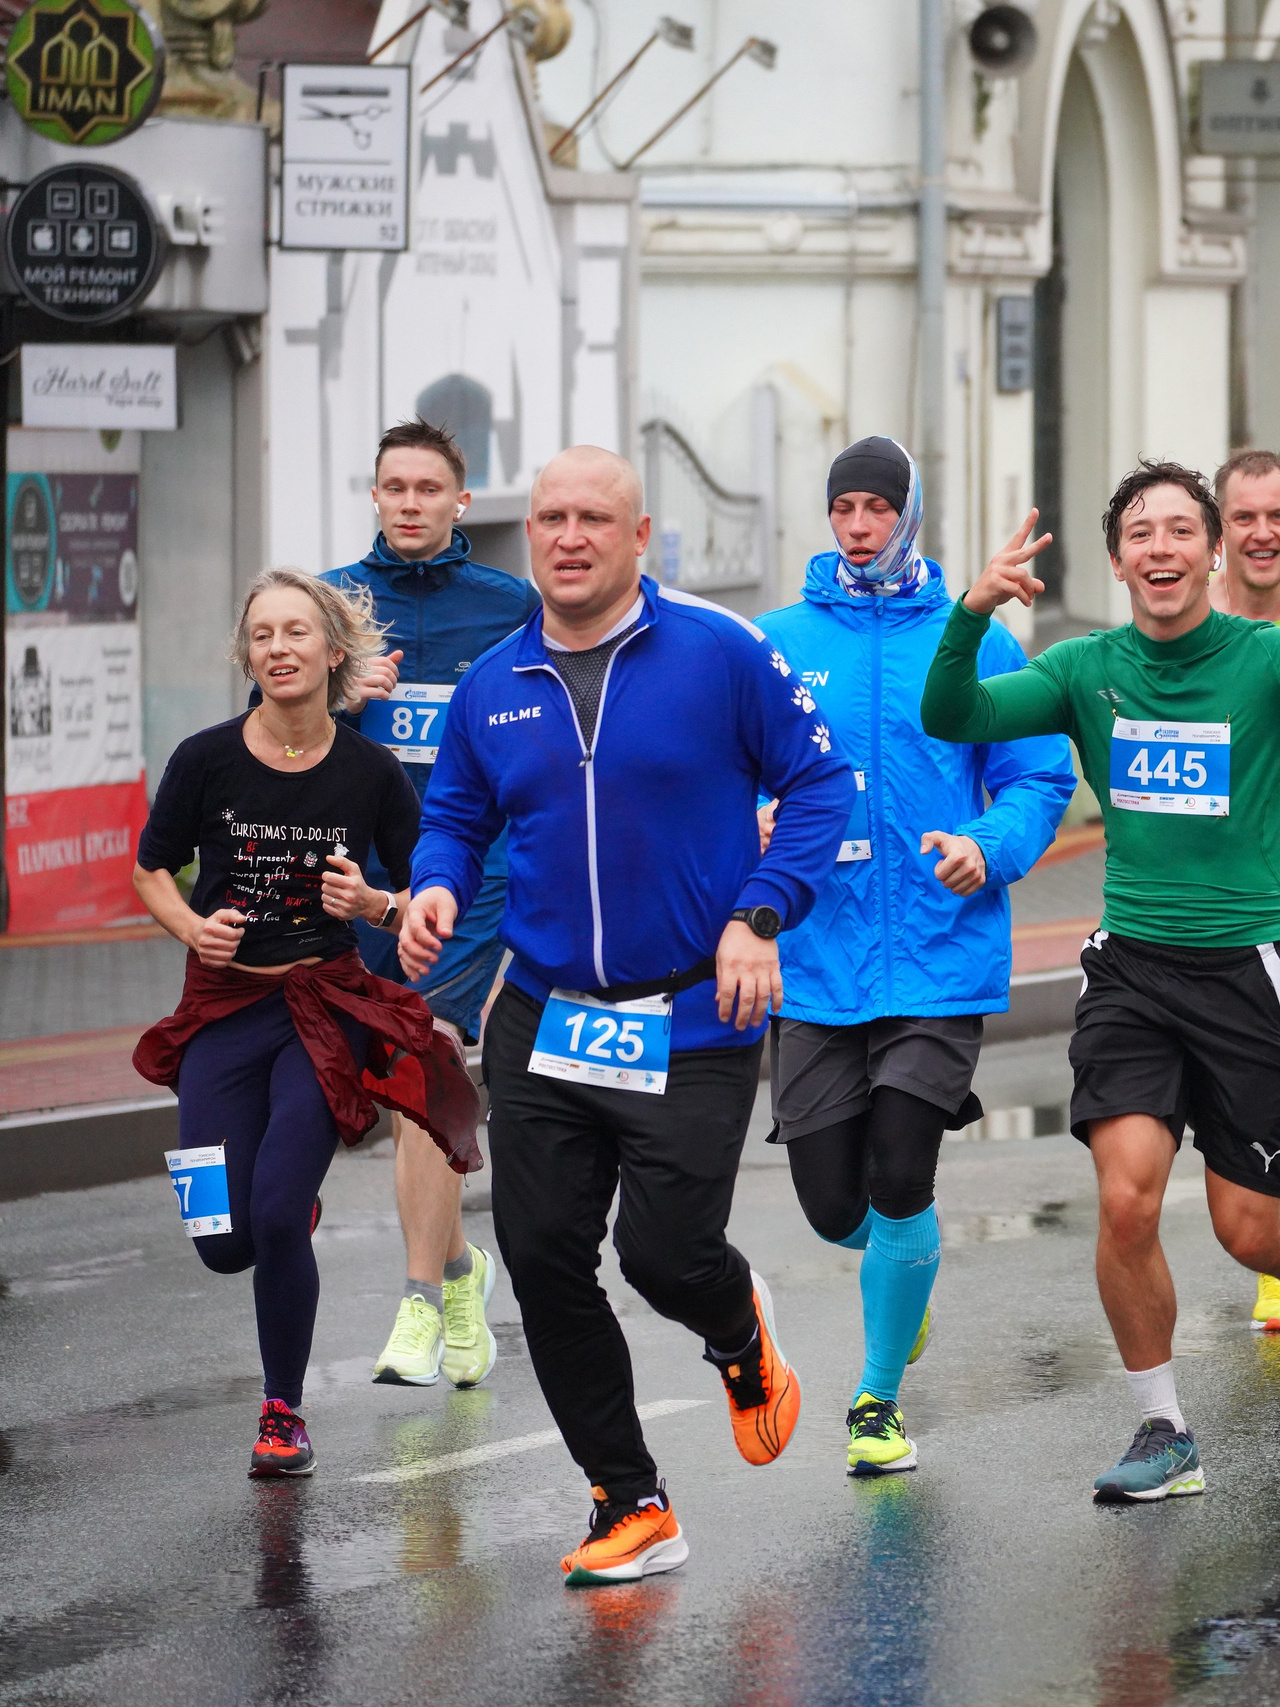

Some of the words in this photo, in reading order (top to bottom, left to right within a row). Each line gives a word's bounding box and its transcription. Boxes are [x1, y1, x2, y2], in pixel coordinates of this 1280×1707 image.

[38, 87, 118, 113] IMAN
[297, 175, 396, 194] МУЖСКИЕ
[294, 200, 393, 217] СТРИЖКИ
[379, 224, 398, 241] 52
[24, 265, 66, 285] МОЙ
[69, 267, 138, 285] РЕМОНТ
[43, 286, 119, 304] ТЕХНИКИ
[32, 364, 106, 396] Hard
[108, 366, 162, 392] Salt
[391, 706, 439, 740] 87
[488, 706, 542, 727] KELME
[1127, 747, 1208, 788] 445
[230, 822, 287, 841] CHRISTMAS
[290, 826, 348, 842] TO-DO-LIST
[246, 841, 259, 853] BE
[264, 866, 290, 886] gifts
[565, 1011, 644, 1063] 125
